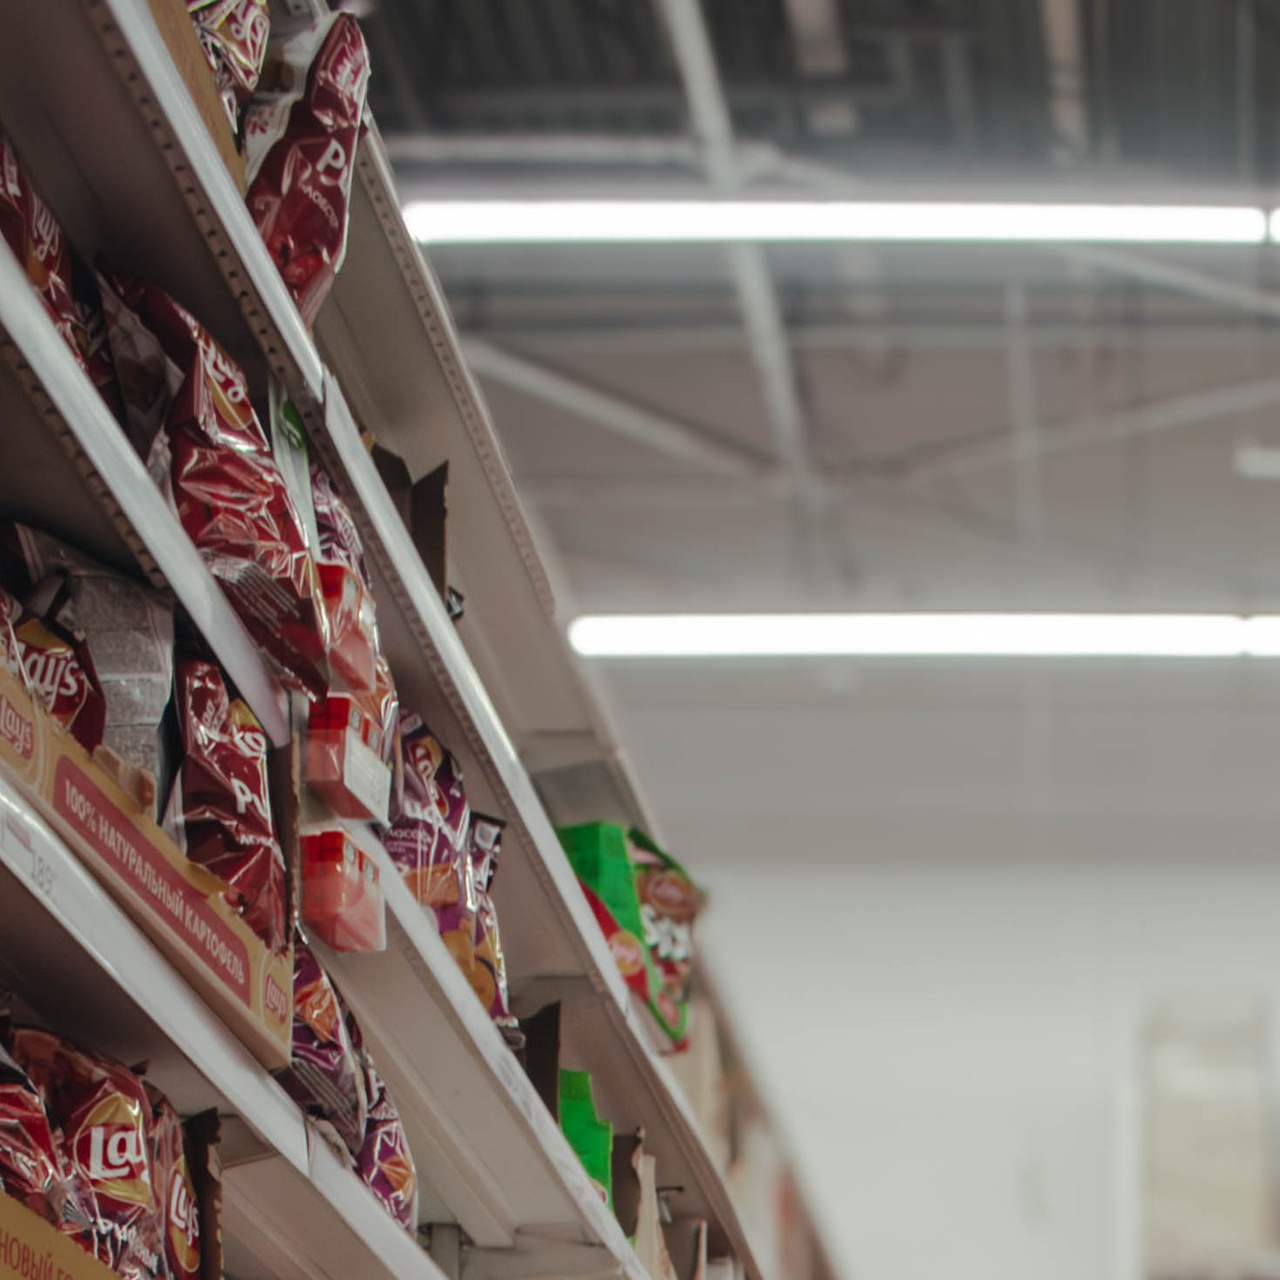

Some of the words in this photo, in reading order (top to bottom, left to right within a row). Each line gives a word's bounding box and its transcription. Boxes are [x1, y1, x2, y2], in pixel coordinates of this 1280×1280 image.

[64, 779, 98, 832] 100%
[99, 816, 184, 925] НАТУРАЛЬНЫЙ
[185, 900, 246, 985] КАРТОФЕЛЬ
